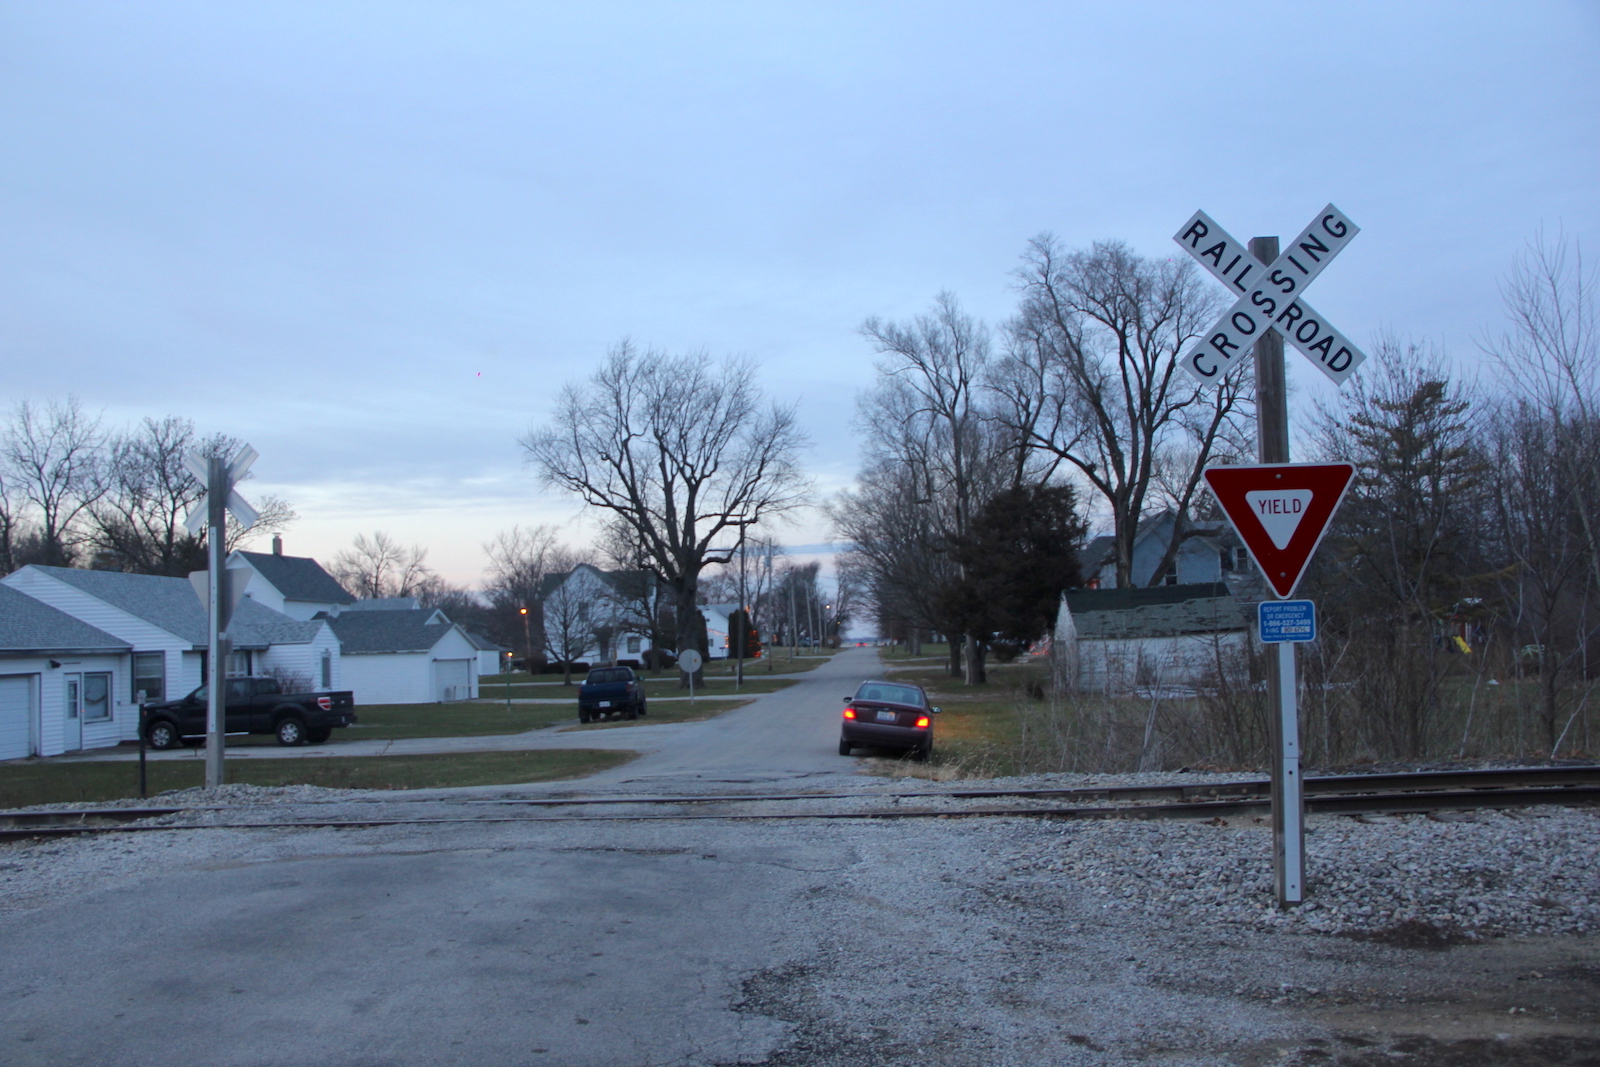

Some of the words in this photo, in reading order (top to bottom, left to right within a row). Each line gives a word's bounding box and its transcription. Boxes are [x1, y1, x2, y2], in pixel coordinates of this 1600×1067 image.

[1182, 219, 1253, 293] RAIL
[1276, 302, 1353, 372] ROAD
[1193, 214, 1347, 377] CROSSING
[1258, 498, 1302, 514] YIELD
